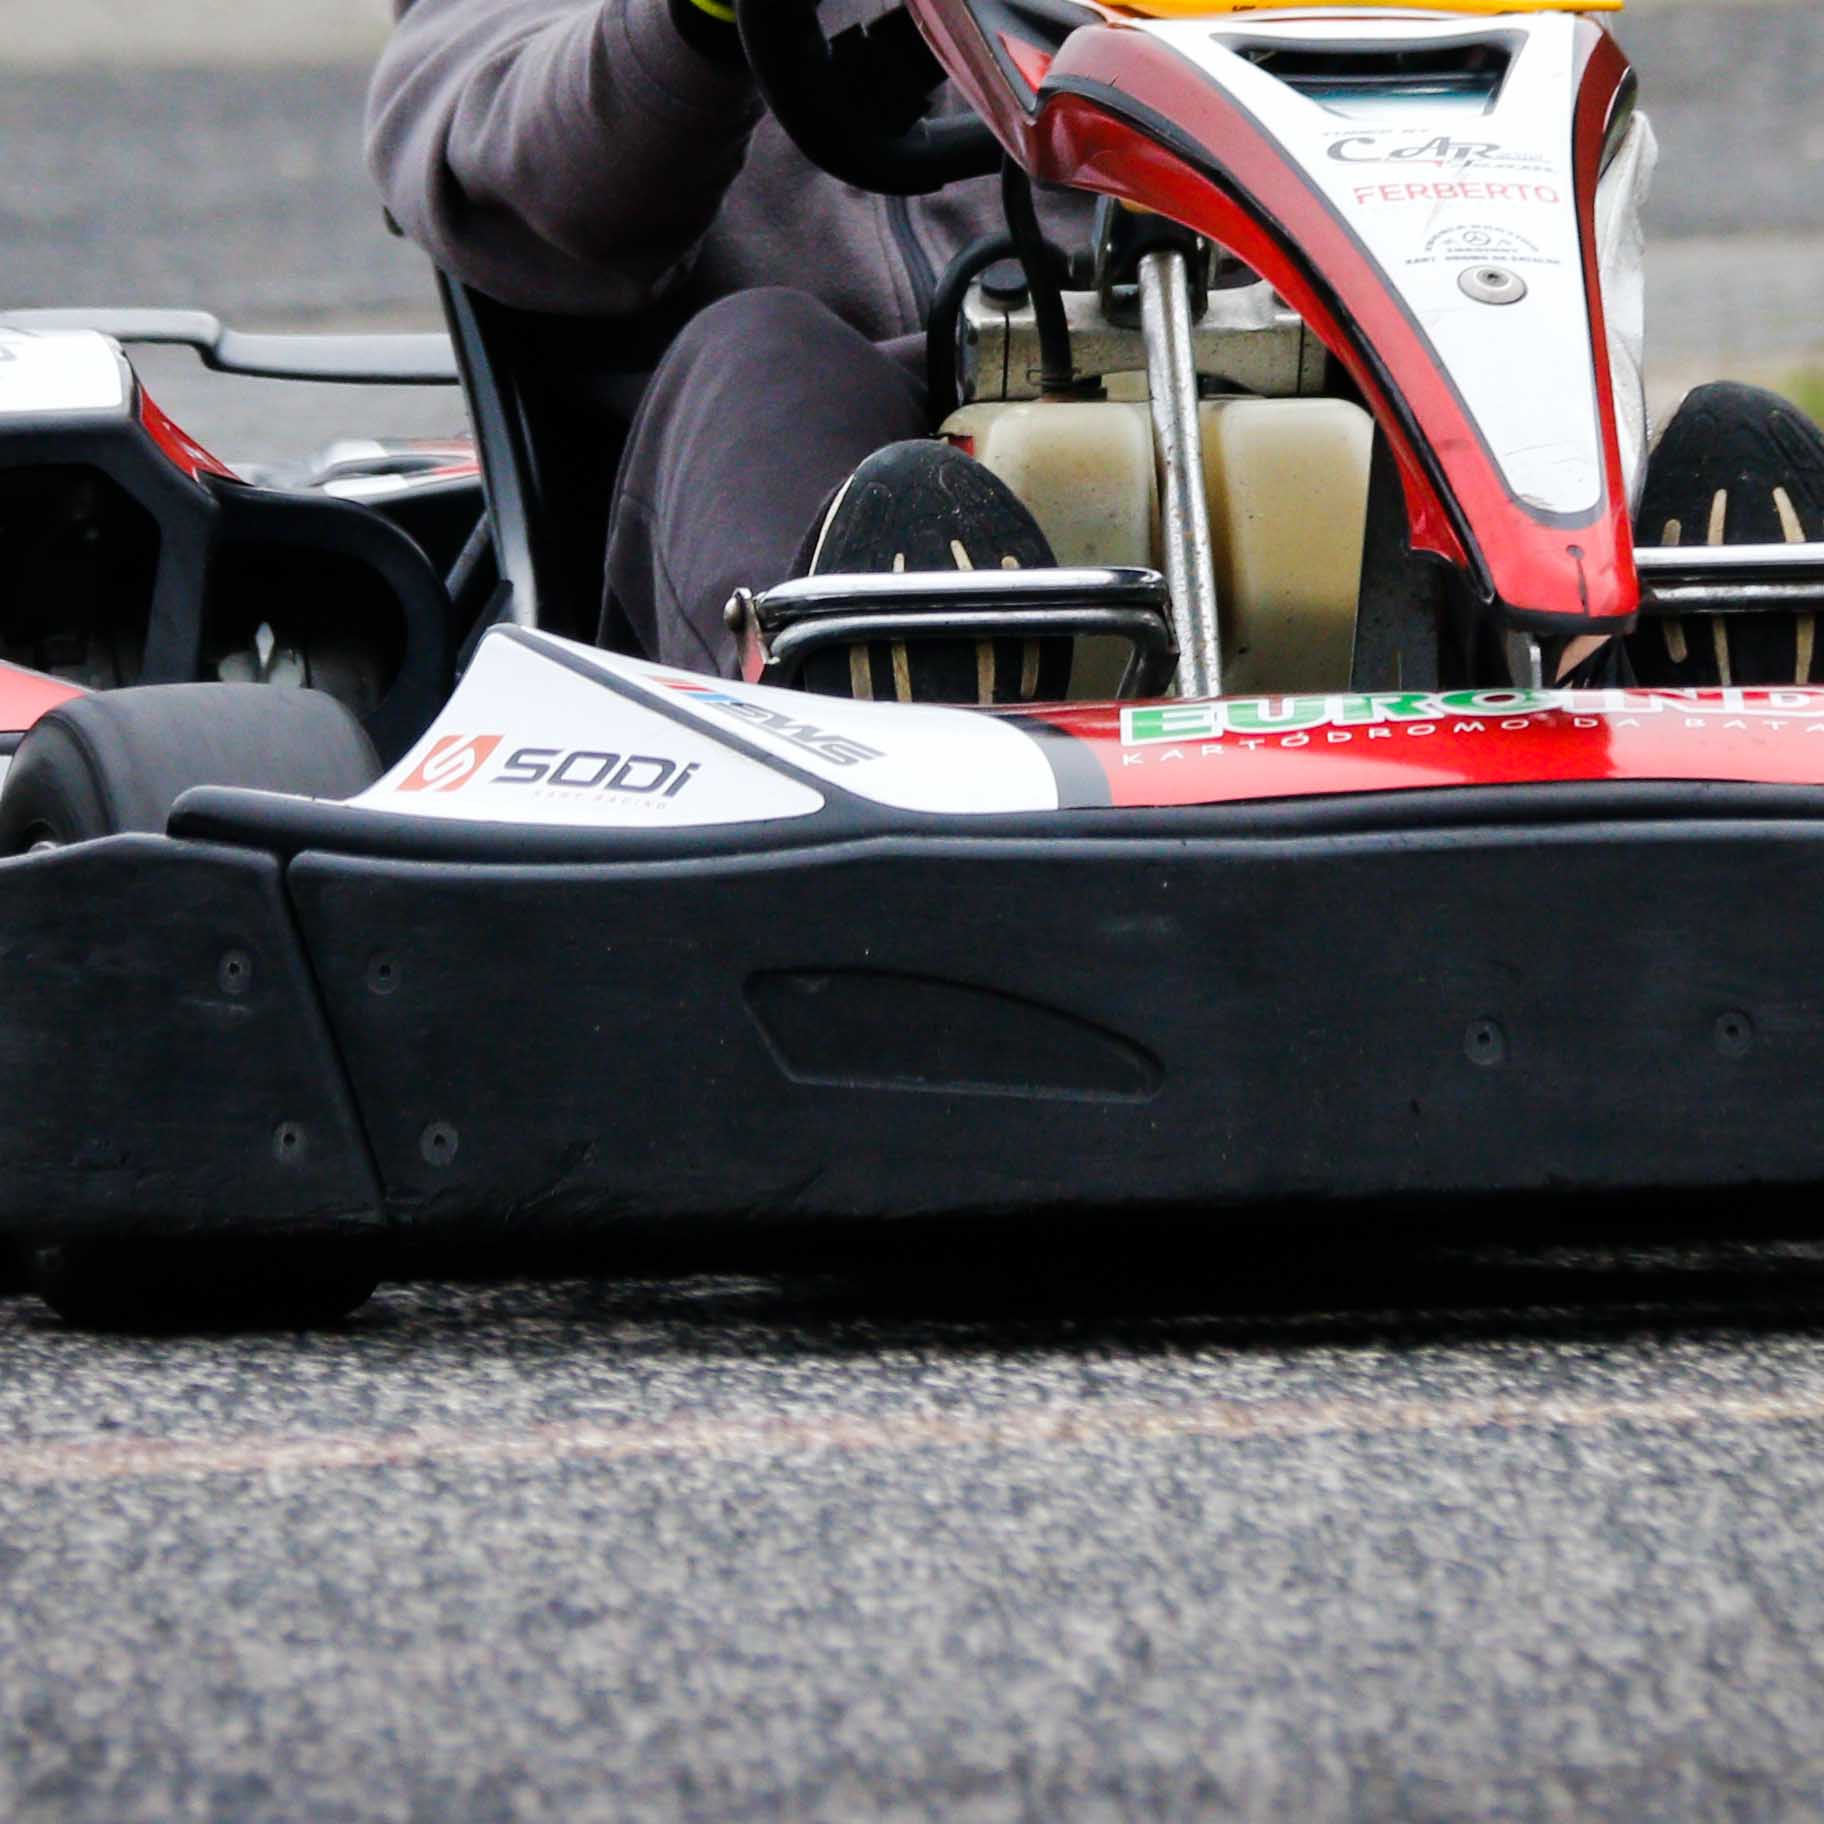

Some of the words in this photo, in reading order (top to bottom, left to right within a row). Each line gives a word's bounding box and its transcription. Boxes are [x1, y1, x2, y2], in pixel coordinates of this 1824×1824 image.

[1353, 182, 1560, 206] FERBERTO
[1122, 719, 1531, 766] KARTÓDROMO
[1573, 716, 1641, 729] DA
